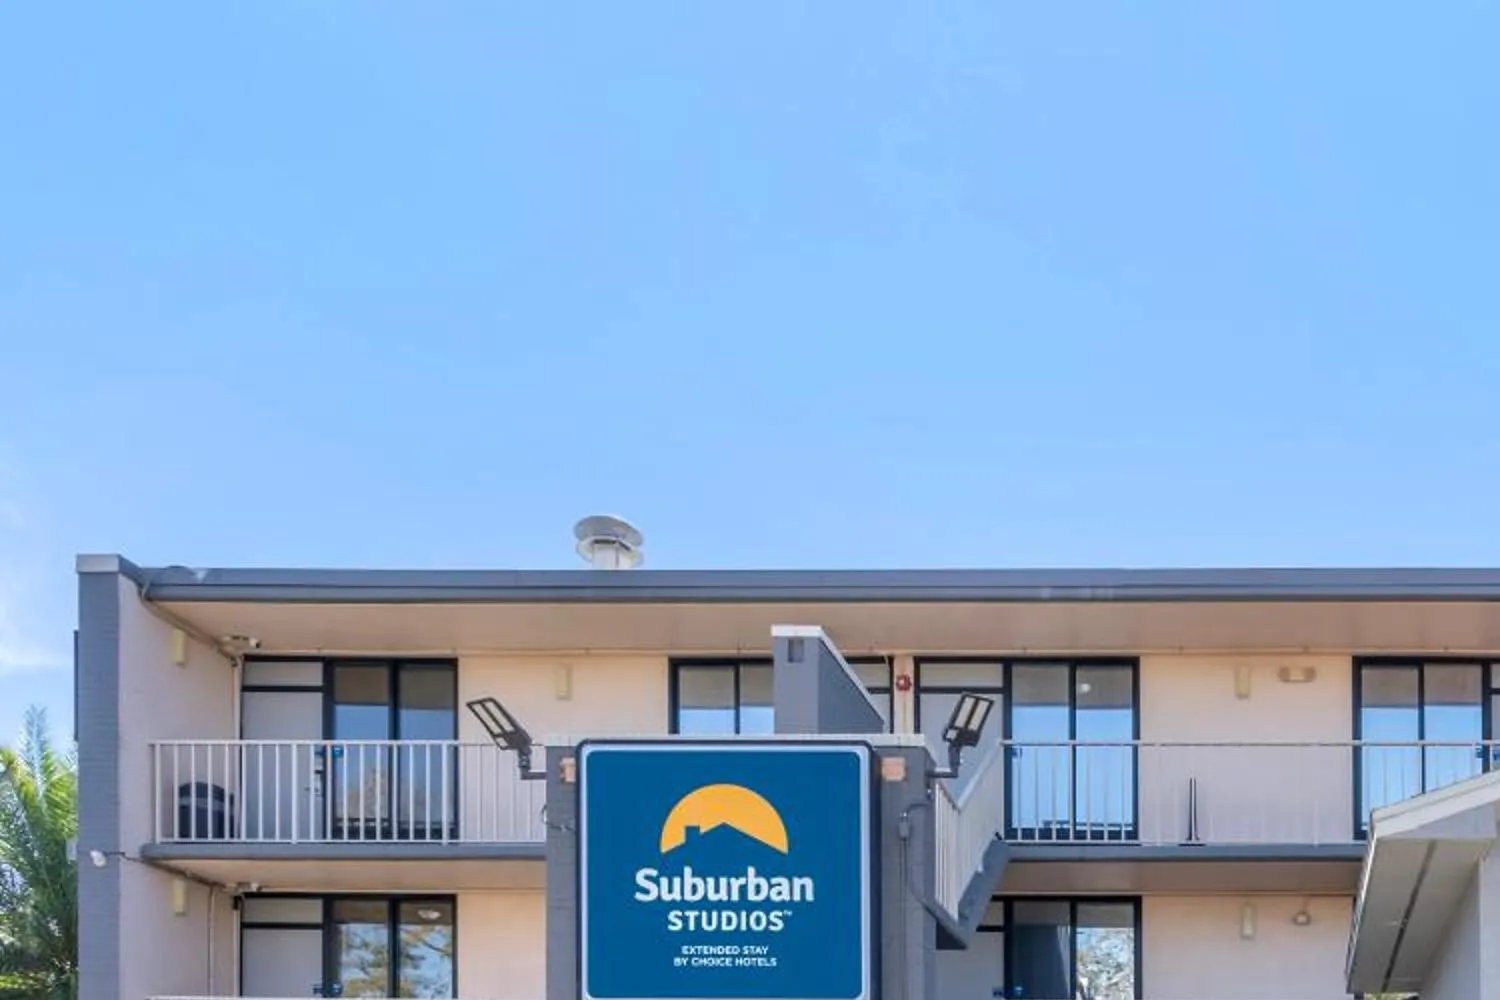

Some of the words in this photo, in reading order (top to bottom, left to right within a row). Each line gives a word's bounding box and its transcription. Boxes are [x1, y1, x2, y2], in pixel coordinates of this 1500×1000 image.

[634, 865, 815, 902] Suburban
[681, 945, 740, 955] EXTENDED
[742, 945, 769, 955] STAY
[673, 957, 689, 967] BY
[691, 957, 733, 967] CHOICE
[735, 957, 777, 967] HOTELS
